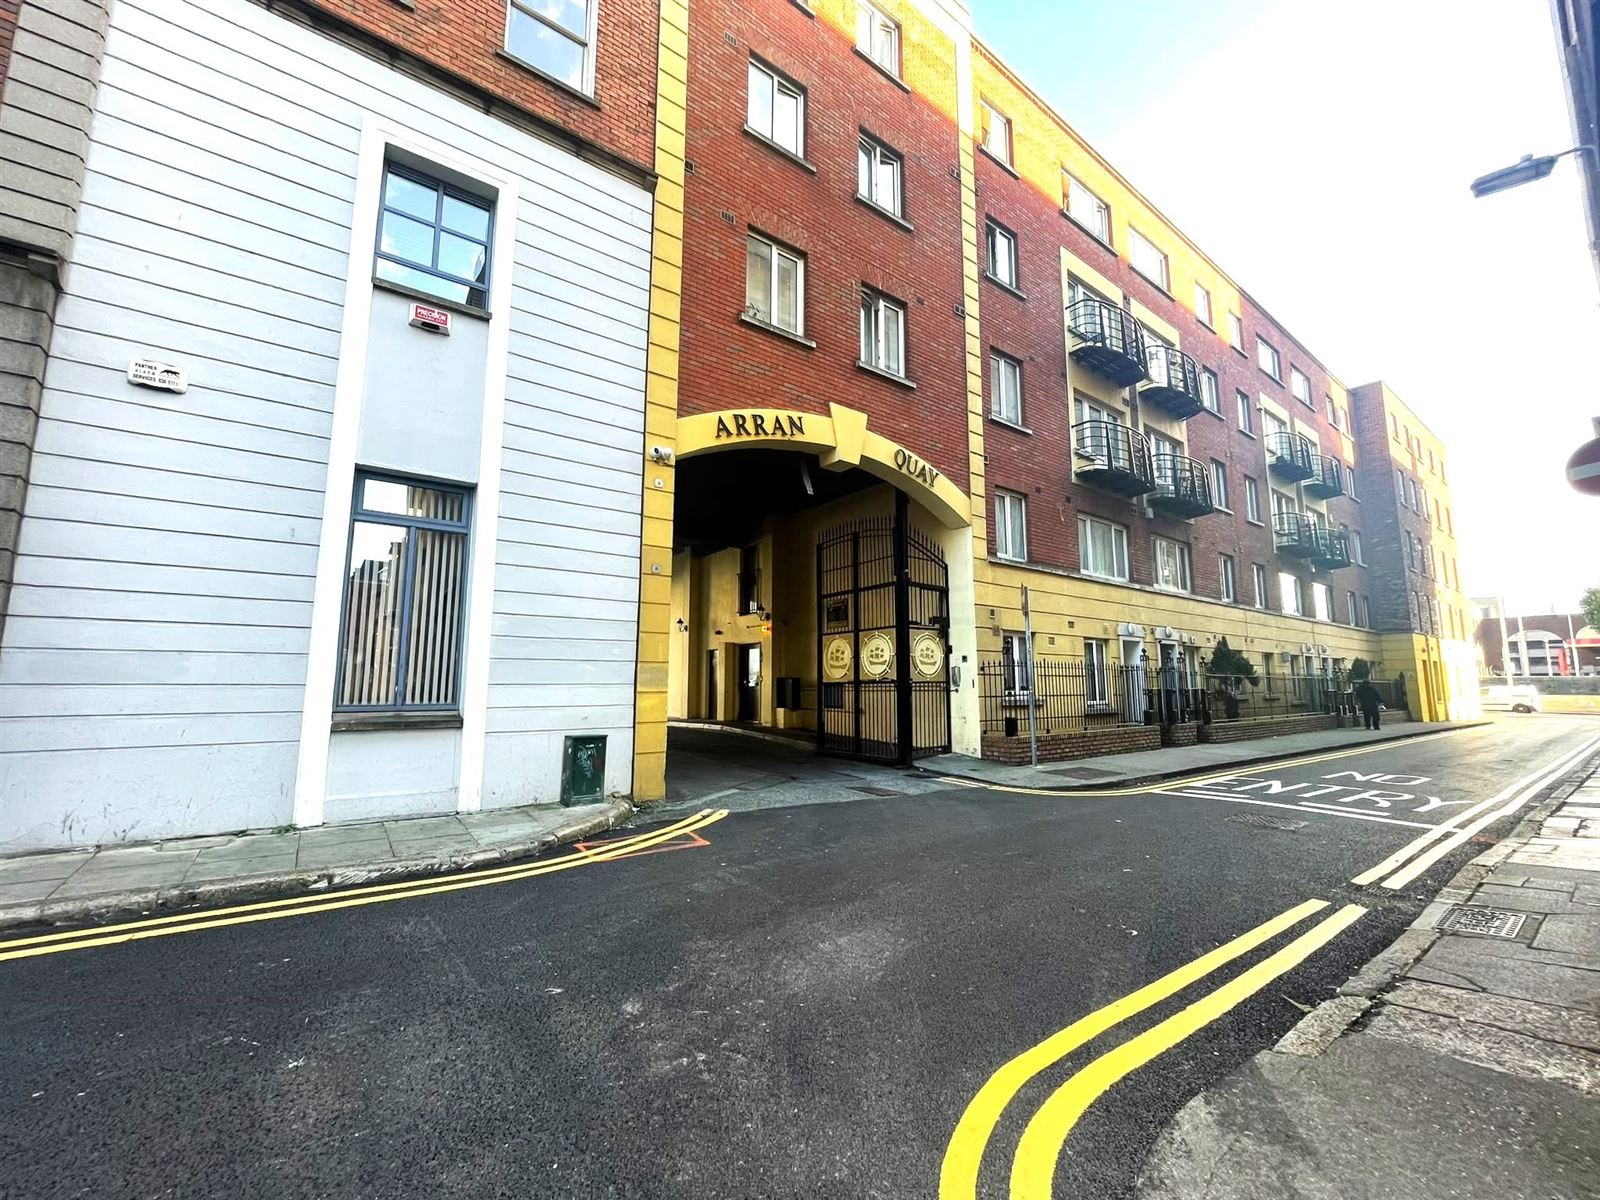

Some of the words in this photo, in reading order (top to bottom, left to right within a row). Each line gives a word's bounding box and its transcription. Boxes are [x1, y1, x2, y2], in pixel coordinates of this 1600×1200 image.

[416, 308, 446, 321] PRECISION
[134, 362, 157, 370] PANTHER
[133, 373, 156, 382] SERVICES
[715, 413, 806, 438] ARRAN
[893, 448, 940, 488] QUAY
[1321, 771, 1432, 785] NO
[1188, 776, 1477, 812] ENTRY
